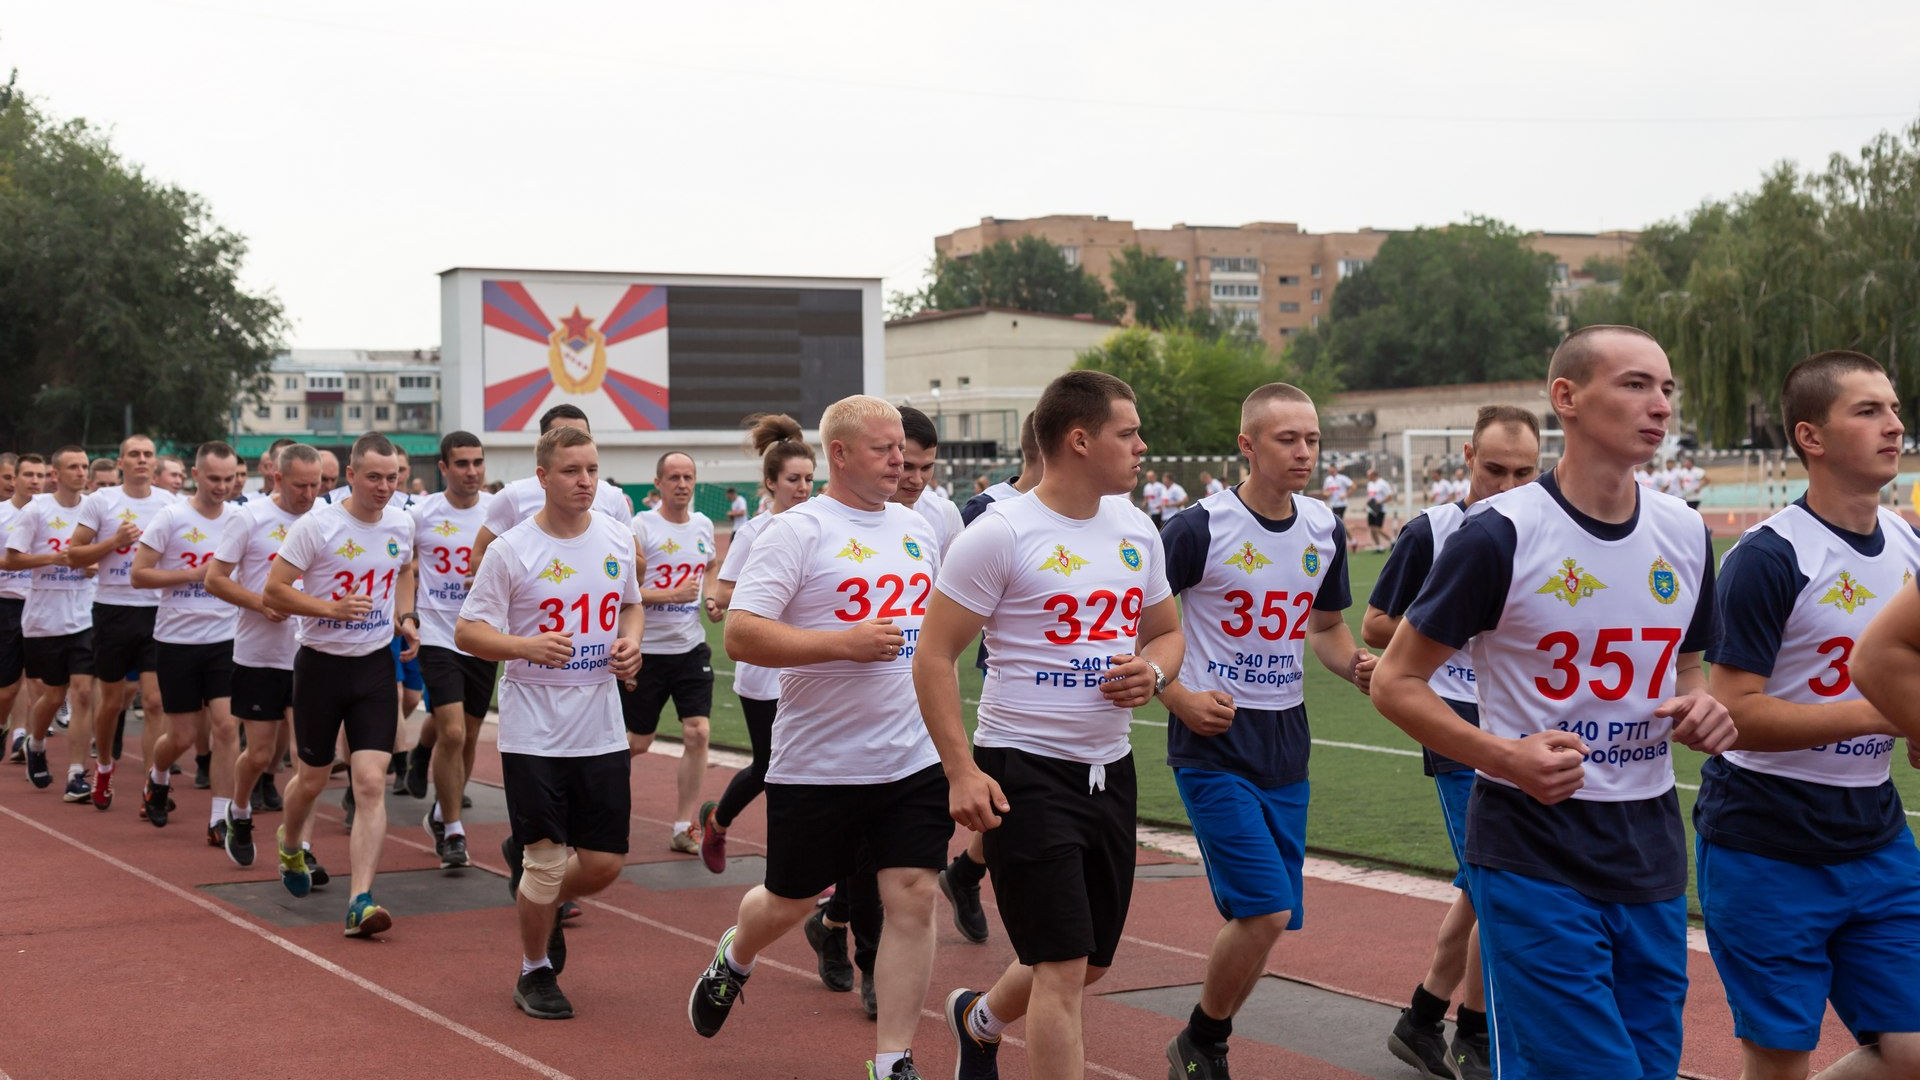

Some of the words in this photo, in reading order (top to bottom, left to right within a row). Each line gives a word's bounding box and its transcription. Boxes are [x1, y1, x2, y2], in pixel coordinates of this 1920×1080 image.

[432, 545, 473, 575] 33
[110, 568, 127, 576] РТБ
[173, 590, 191, 598] РТБ
[331, 568, 395, 601] 311
[429, 589, 447, 599] РТБ
[443, 582, 461, 591] 340
[834, 572, 932, 622] 322
[538, 591, 620, 634] 316
[1043, 587, 1144, 645] 329
[1220, 589, 1314, 641] 352
[318, 618, 342, 630] РТБ
[581, 643, 605, 657] РТП
[560, 657, 613, 671] Бобров
[1069, 656, 1101, 671] 340
[1235, 652, 1263, 668] 340
[1268, 655, 1294, 669] РТП
[1534, 628, 1682, 701] 357
[1035, 671, 1078, 688] РТБ
[1207, 660, 1239, 681] РТБ
[1244, 669, 1303, 688] Бобровка
[1557, 720, 1599, 741] 340
[1608, 720, 1650, 741] РТП
[1835, 738, 1896, 759] Бобров
